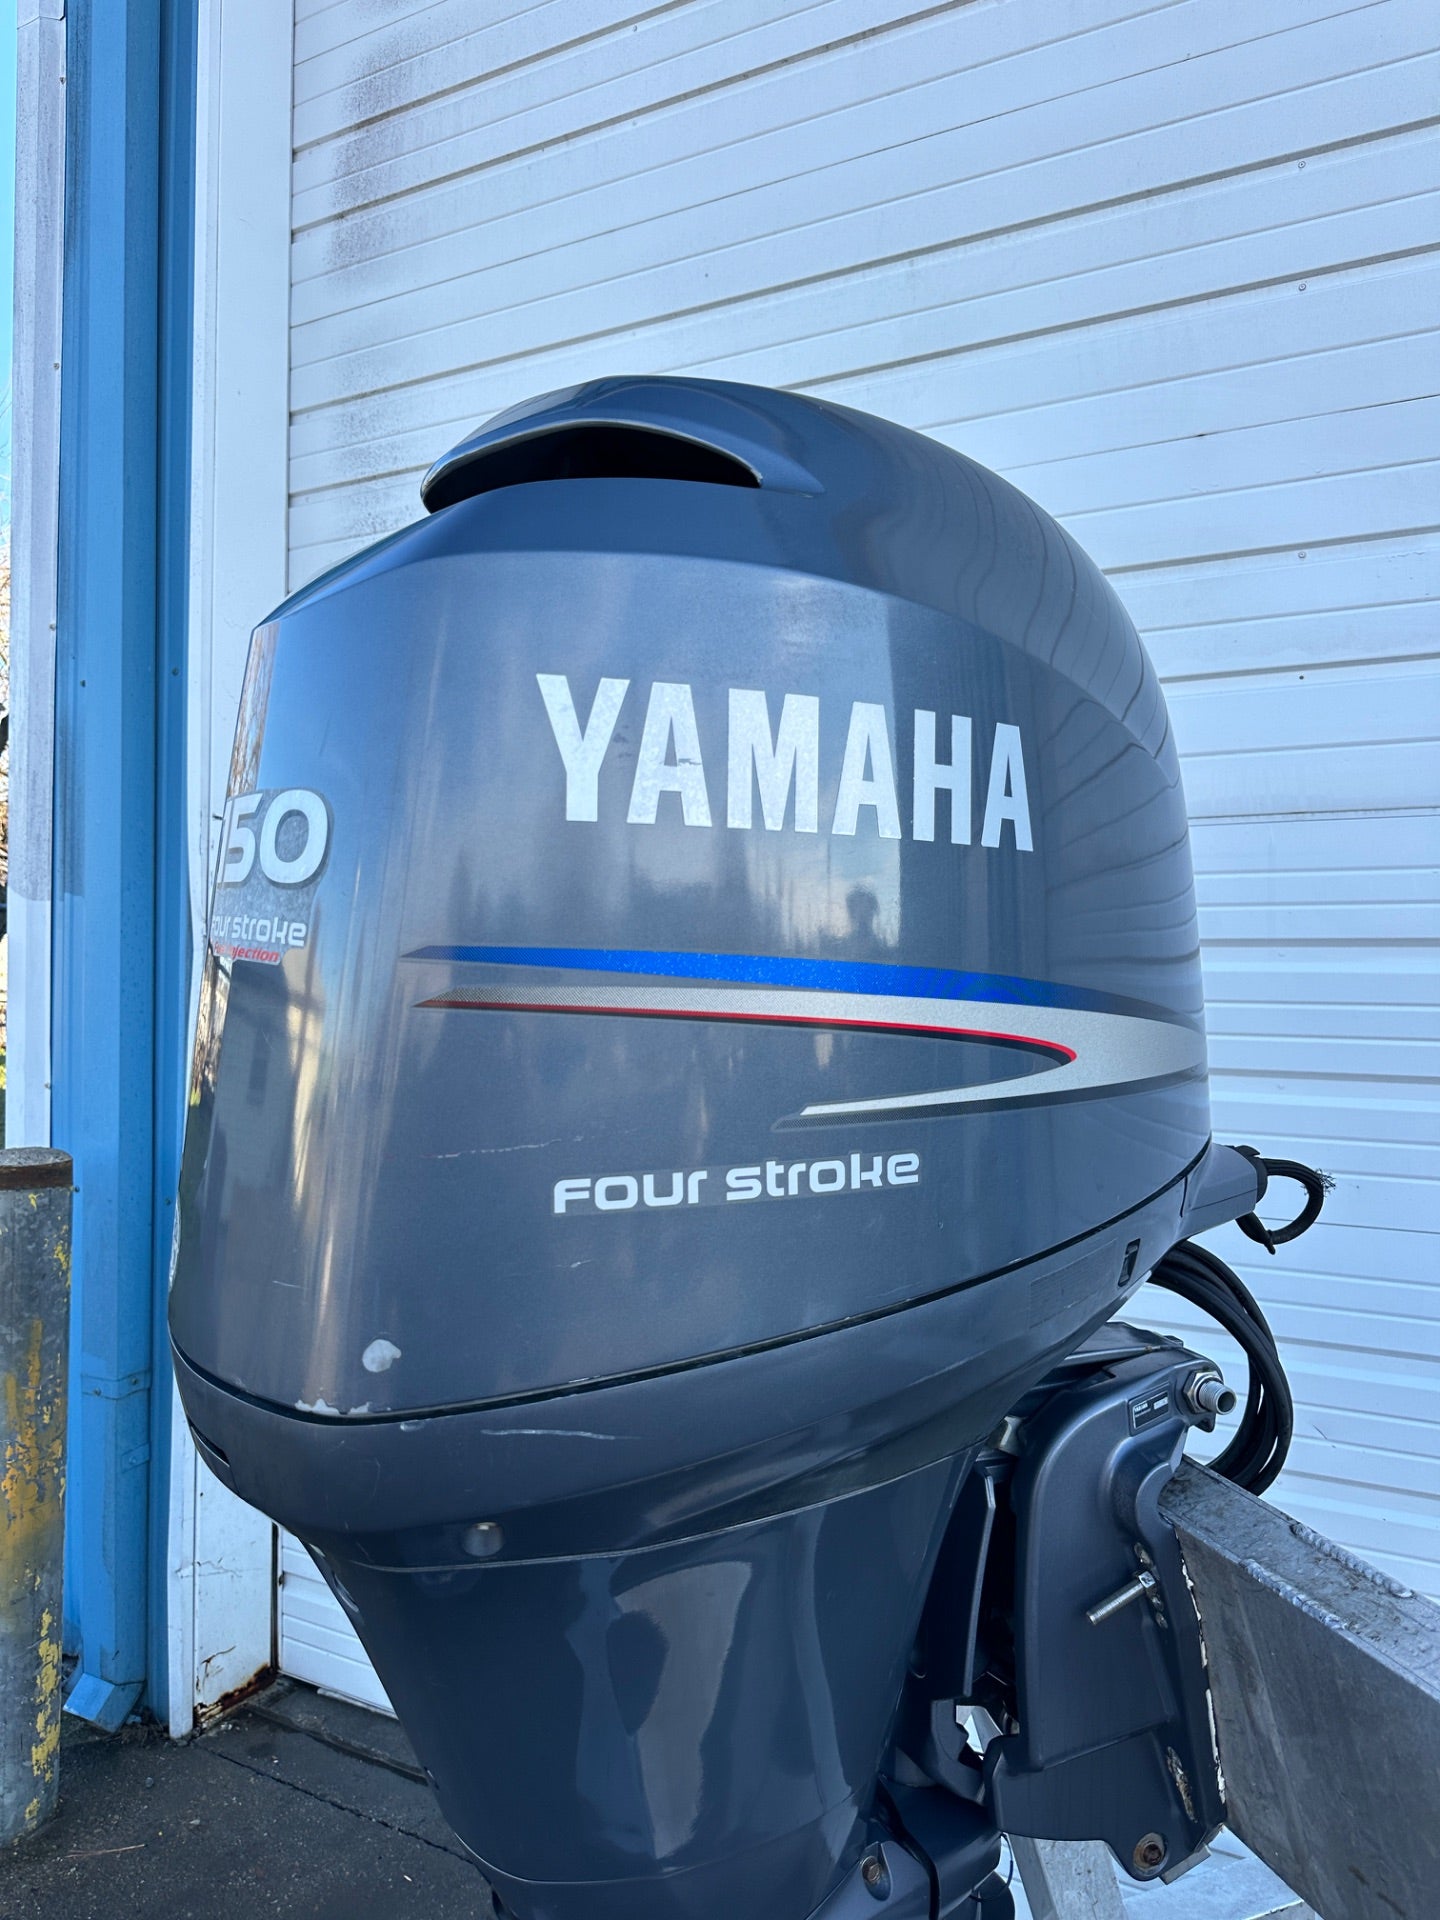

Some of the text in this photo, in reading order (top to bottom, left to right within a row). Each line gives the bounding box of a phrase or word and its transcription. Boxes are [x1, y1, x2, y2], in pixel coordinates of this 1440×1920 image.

[536, 673, 1034, 852] YAMAHA
[228, 944, 280, 963] njection
[231, 914, 307, 947] stroke
[553, 1152, 920, 1213] Four stroke
